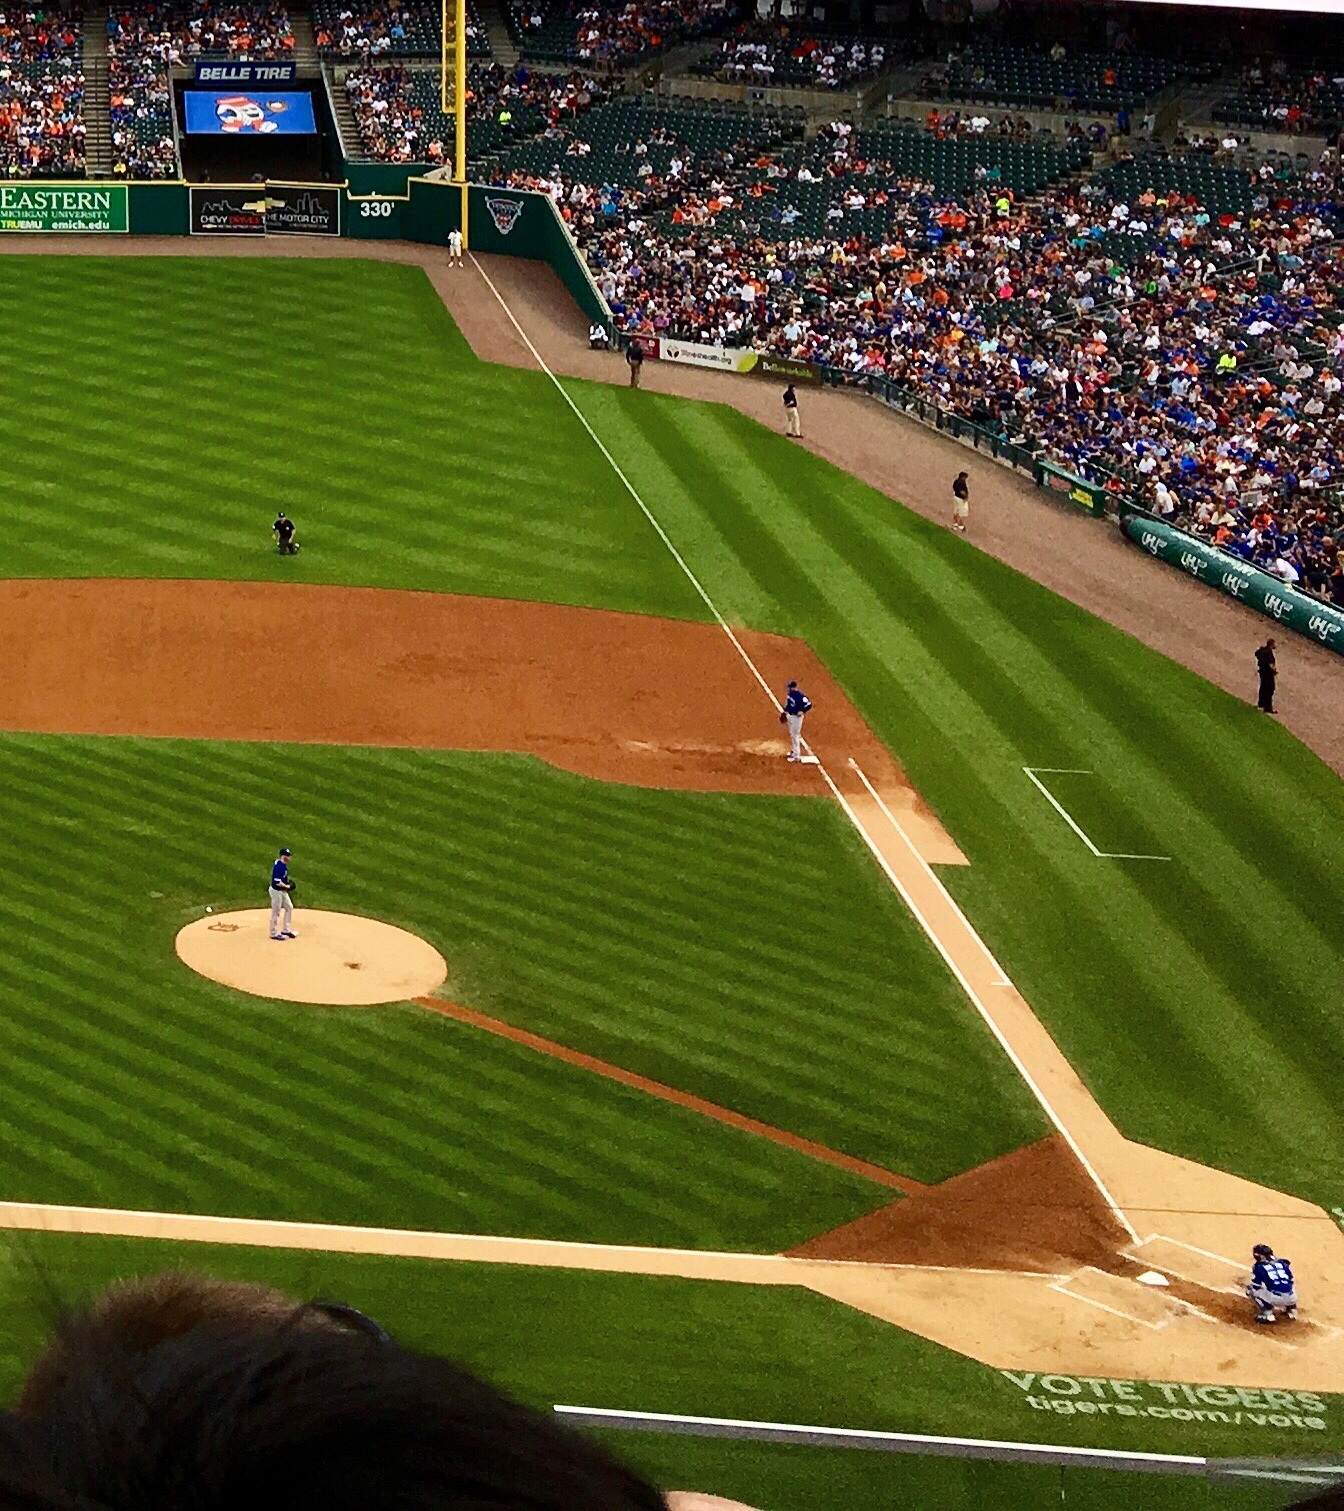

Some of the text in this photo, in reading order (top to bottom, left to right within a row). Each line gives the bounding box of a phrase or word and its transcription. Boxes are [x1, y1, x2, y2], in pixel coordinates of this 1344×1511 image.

[199, 67, 292, 80] BELLE TIRE
[0, 187, 111, 210] EASTERN
[0, 210, 110, 219] MICHIGAN UNIVERSITY
[360, 201, 395, 217] 330'
[0, 219, 110, 230] TRUEMU emich.edu
[200, 215, 228, 224] CHEVY
[279, 213, 310, 224] MOTOR
[310, 215, 330, 225] CITY
[999, 1370, 1328, 1413] VOTE TIGERS
[1024, 1394, 1327, 1431] tigers.com/vote
